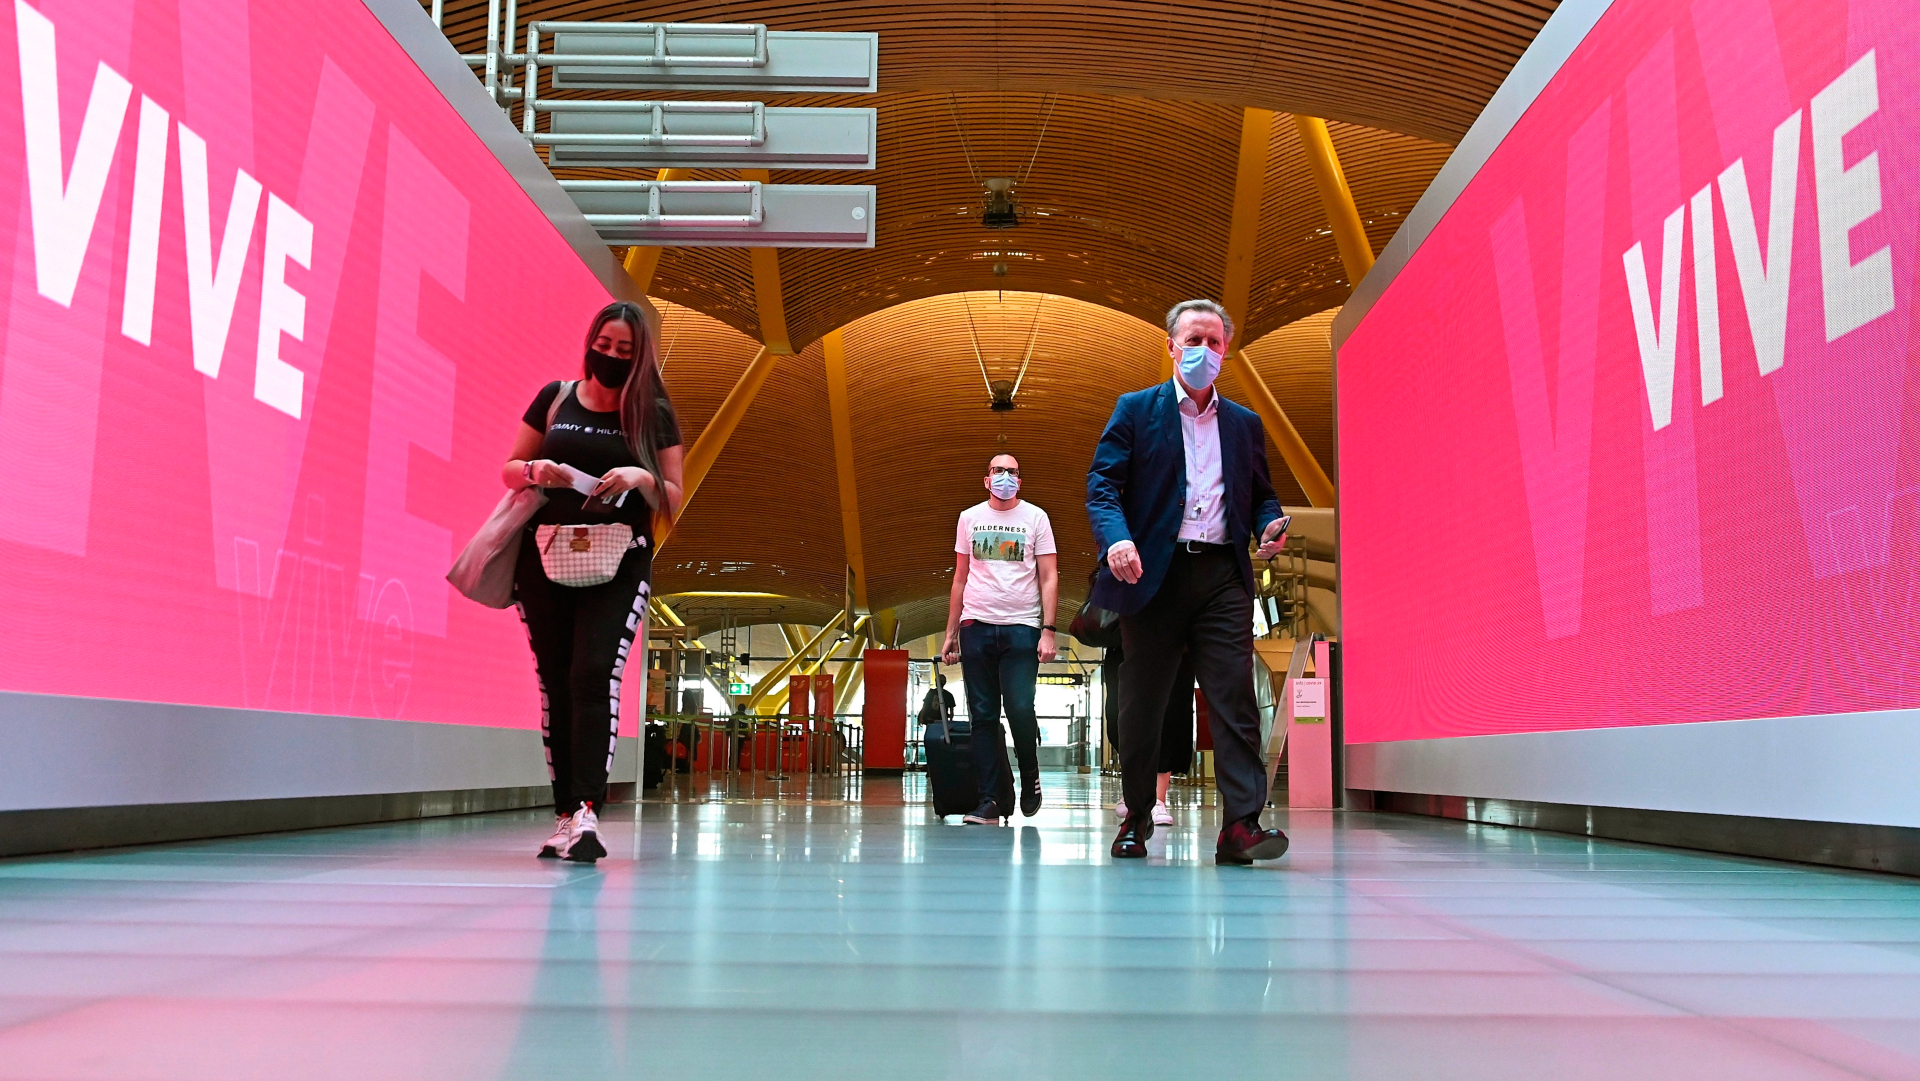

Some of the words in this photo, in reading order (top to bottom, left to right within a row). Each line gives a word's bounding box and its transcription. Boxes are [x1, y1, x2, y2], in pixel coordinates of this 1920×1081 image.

[14, 0, 314, 420] VIVE
[1622, 47, 1895, 432] VIVE
[973, 525, 1026, 533] WILDERNESS
